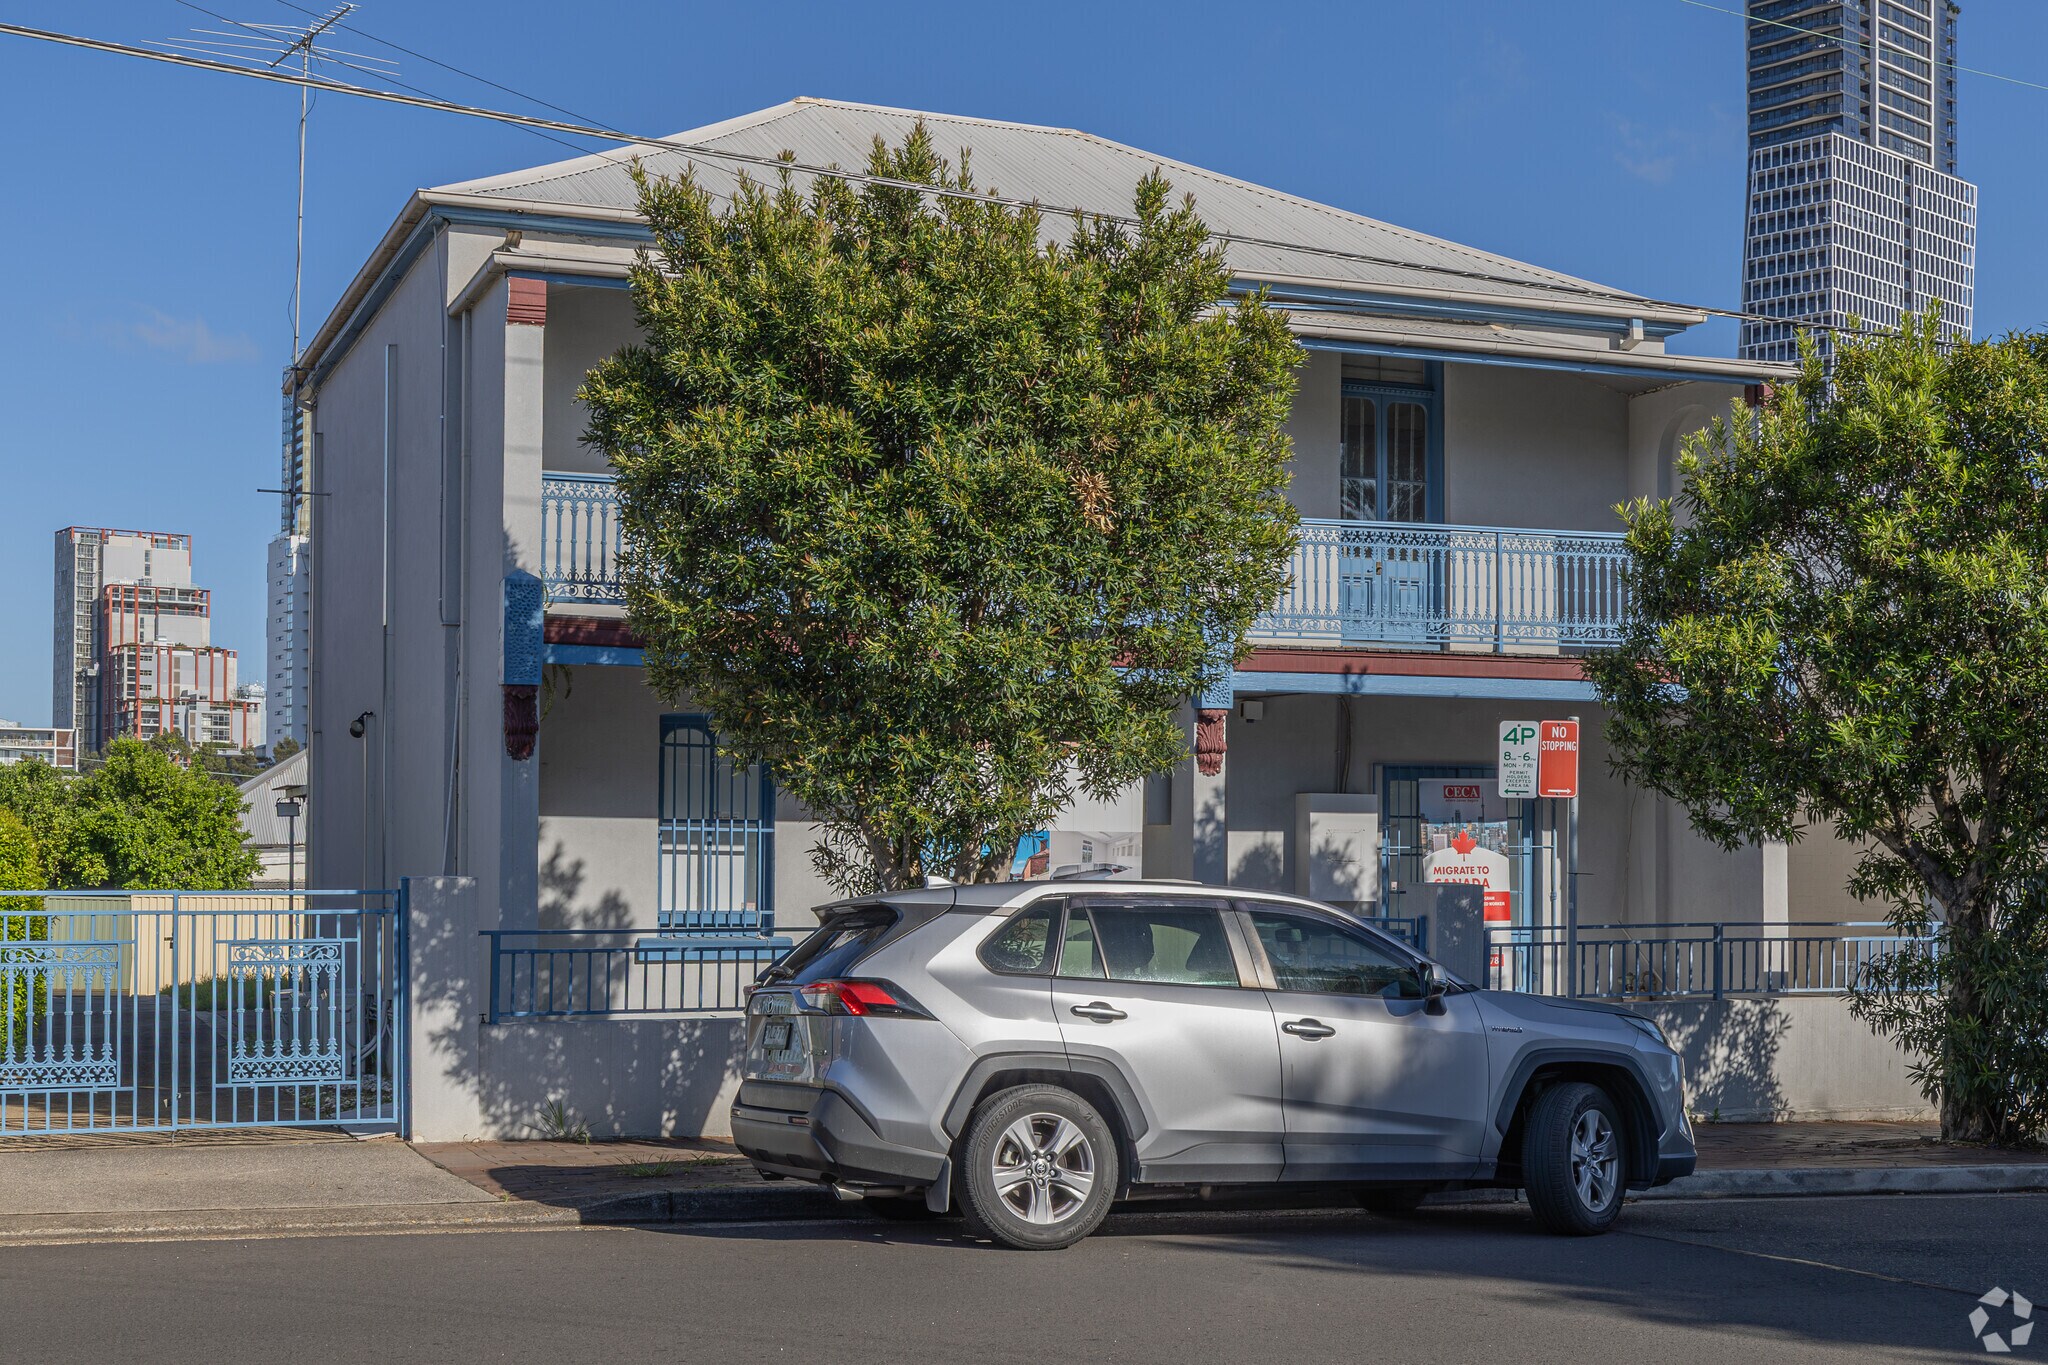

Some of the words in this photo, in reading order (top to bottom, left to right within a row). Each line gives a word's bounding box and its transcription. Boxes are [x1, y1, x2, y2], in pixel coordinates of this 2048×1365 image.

[1503, 727, 1535, 745] 4P
[1552, 726, 1567, 739] NO
[1542, 740, 1577, 751] STOPPING
[1445, 786, 1479, 798] CECA
[1433, 866, 1475, 875] MIGRATE
[1477, 866, 1490, 875] TO
[978, 1098, 1024, 1150] BRIDGESTONE
